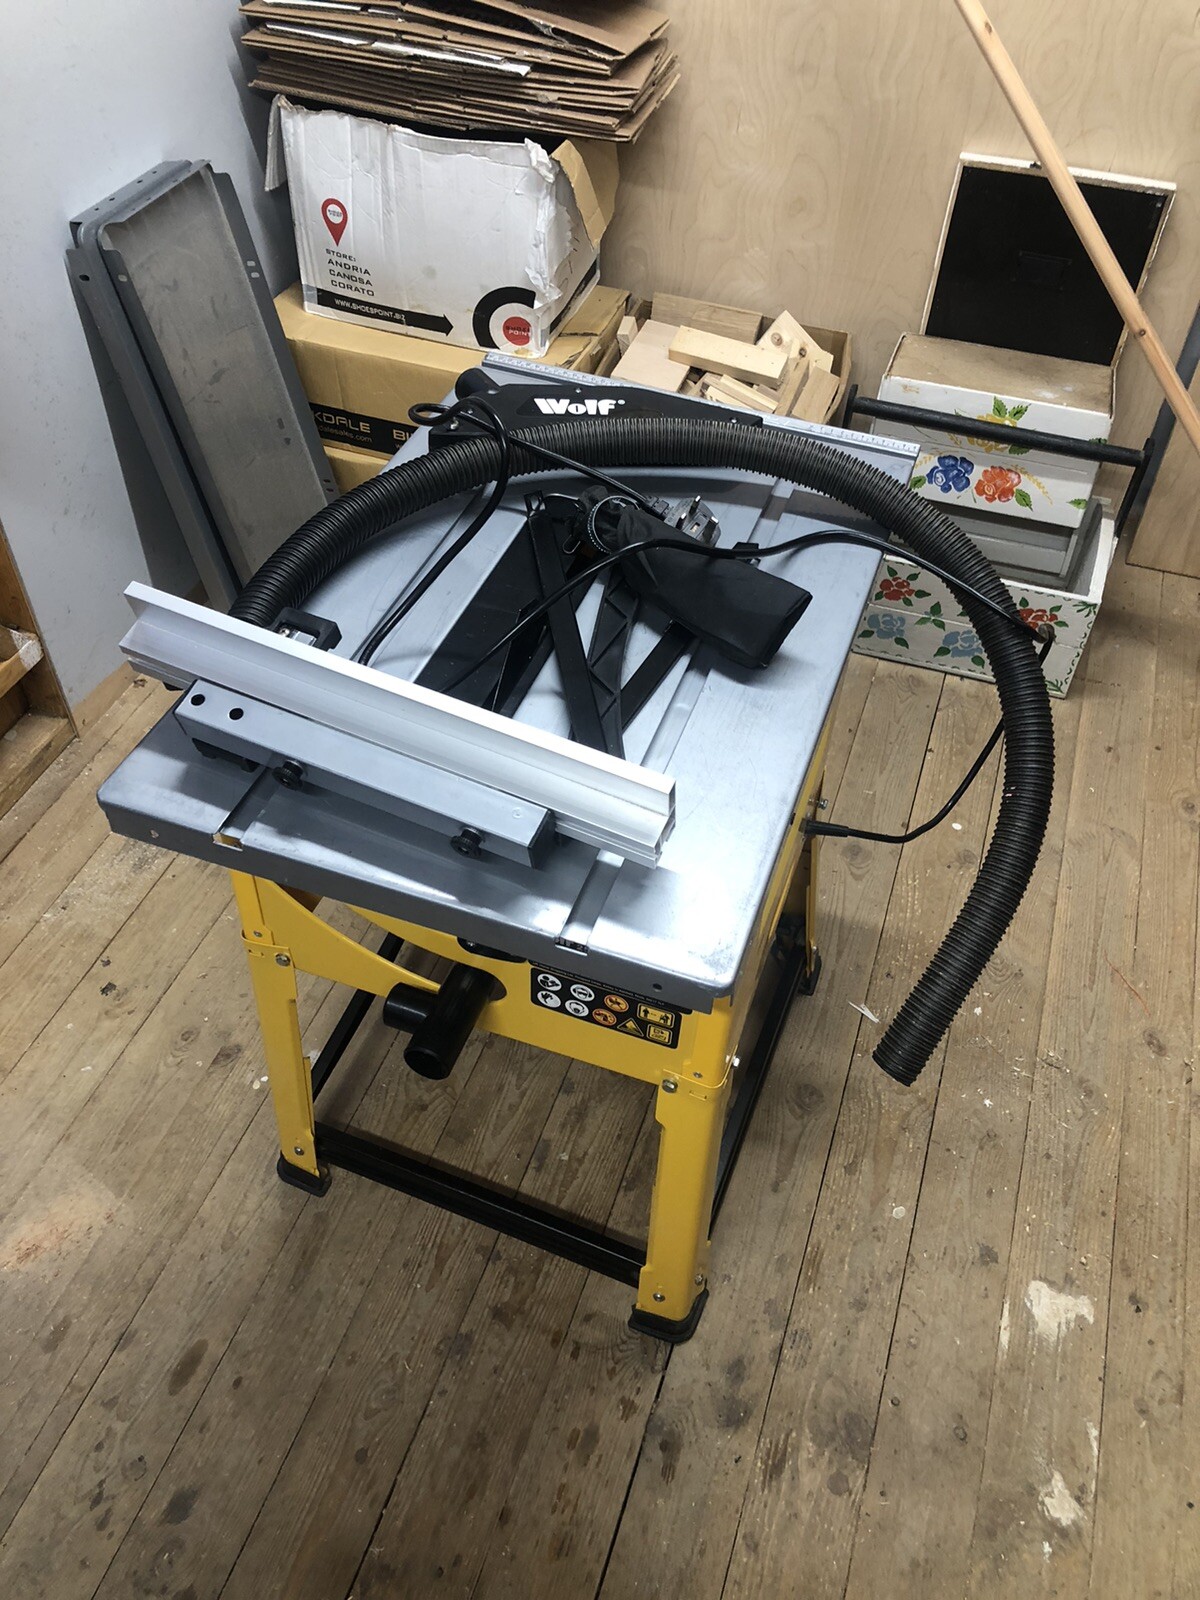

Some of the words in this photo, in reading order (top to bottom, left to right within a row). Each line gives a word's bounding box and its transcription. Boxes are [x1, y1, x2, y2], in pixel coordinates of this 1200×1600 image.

[325, 248, 356, 262] STORE:
[327, 258, 371, 276] ANDRIA
[328, 268, 373, 287] CANOSA
[331, 279, 375, 297] CORATO
